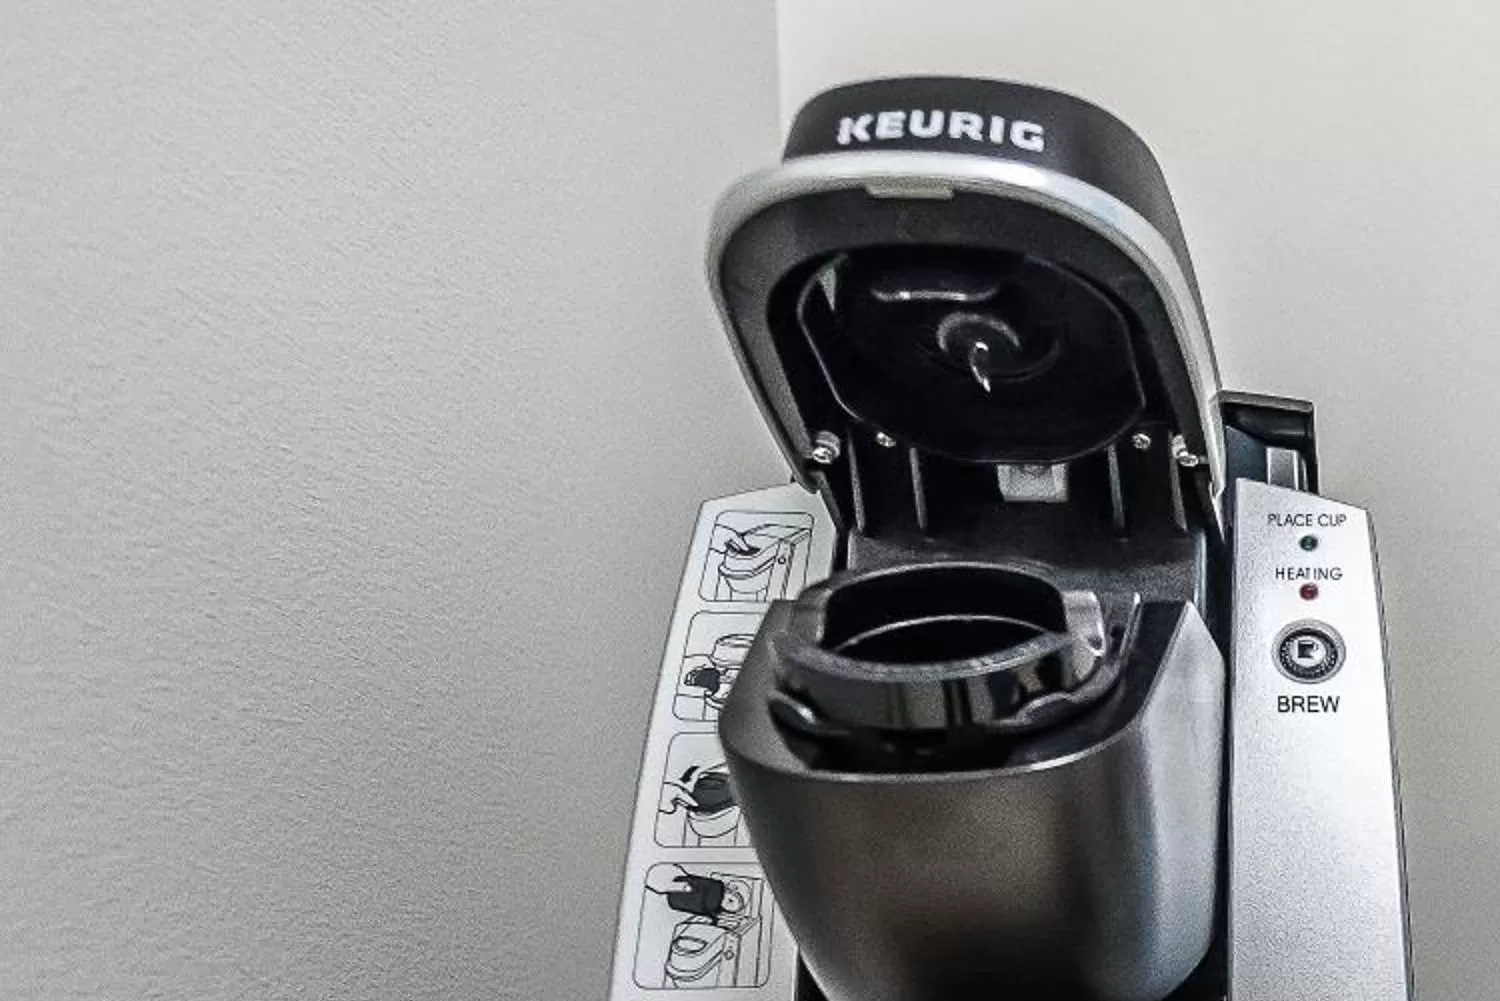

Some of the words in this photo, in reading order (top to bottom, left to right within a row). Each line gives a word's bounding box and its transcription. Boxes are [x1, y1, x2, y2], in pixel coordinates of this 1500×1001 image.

[836, 109, 1045, 152] KEURIG
[1267, 513, 1313, 527] PLACE
[1317, 513, 1347, 527] CUP
[1275, 567, 1343, 580] HEATING
[1277, 695, 1341, 713] BREW
